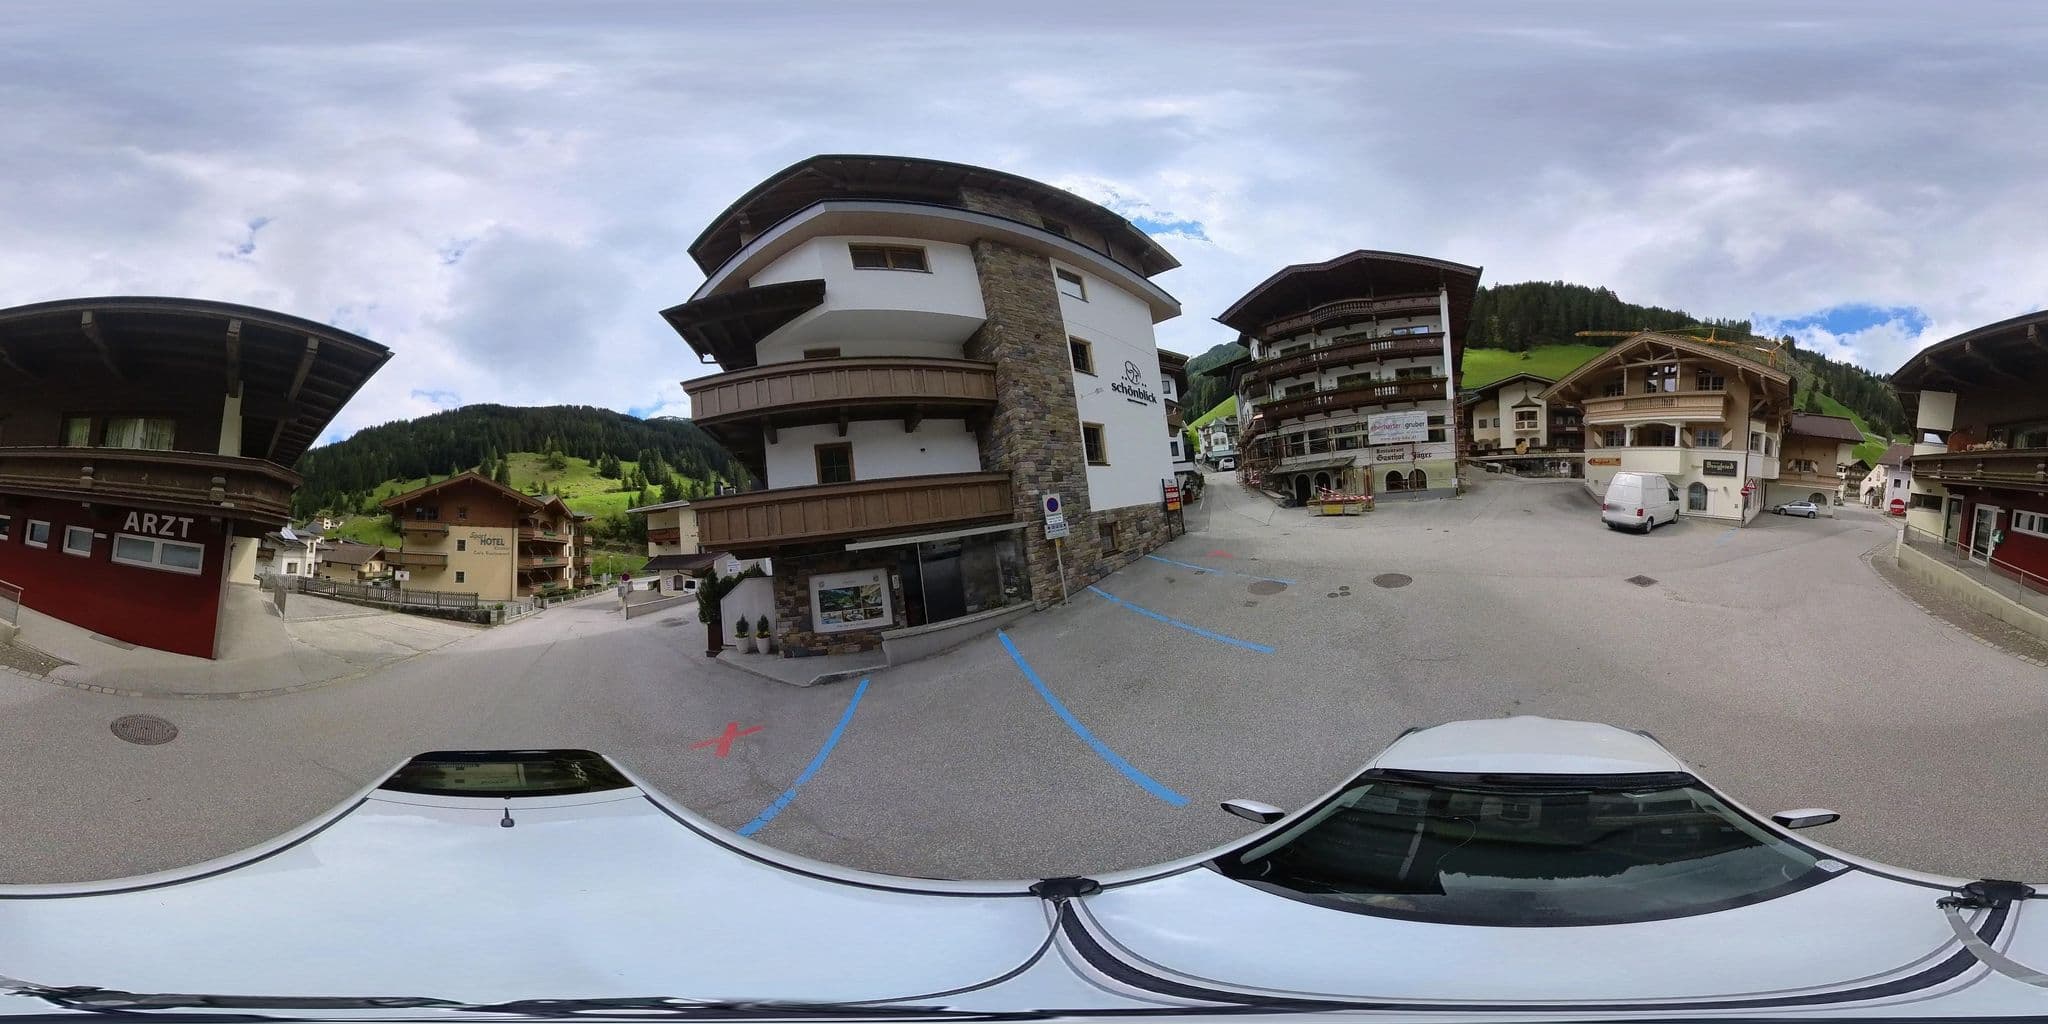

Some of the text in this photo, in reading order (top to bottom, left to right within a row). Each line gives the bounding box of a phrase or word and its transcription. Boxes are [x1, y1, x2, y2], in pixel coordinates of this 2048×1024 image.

[1111, 381, 1158, 404] schönblick
[1404, 420, 1425, 429] gruber
[123, 511, 194, 538] ARZT
[480, 537, 505, 546] HOTEL
